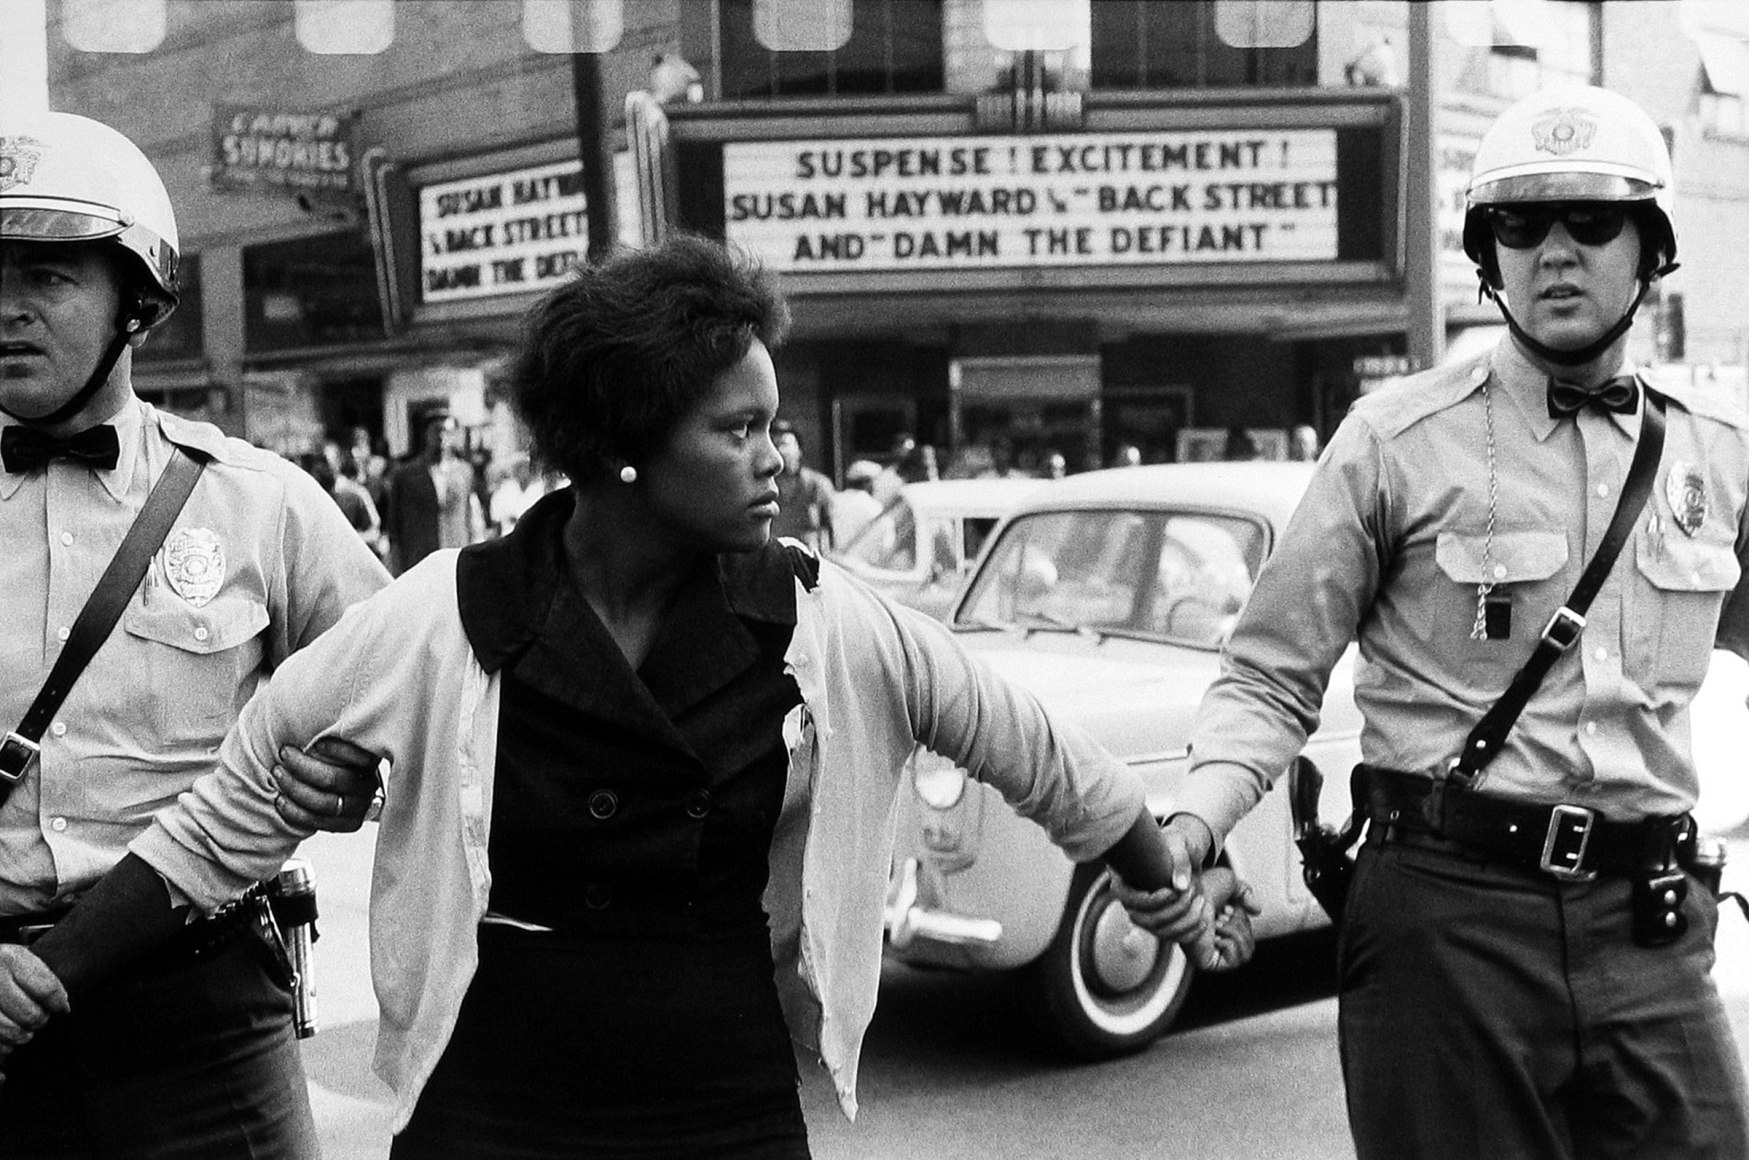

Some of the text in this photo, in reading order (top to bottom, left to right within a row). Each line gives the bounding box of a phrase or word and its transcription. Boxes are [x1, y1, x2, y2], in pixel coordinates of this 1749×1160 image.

[797, 148, 991, 178] SUSPENSE
[1031, 141, 1265, 173] EXCITEMENT
[731, 191, 846, 221] SUSAN
[866, 188, 1037, 218] HAYWARD
[1203, 180, 1334, 211] STREET
[793, 234, 865, 261] AND
[1022, 227, 1092, 255] THE
